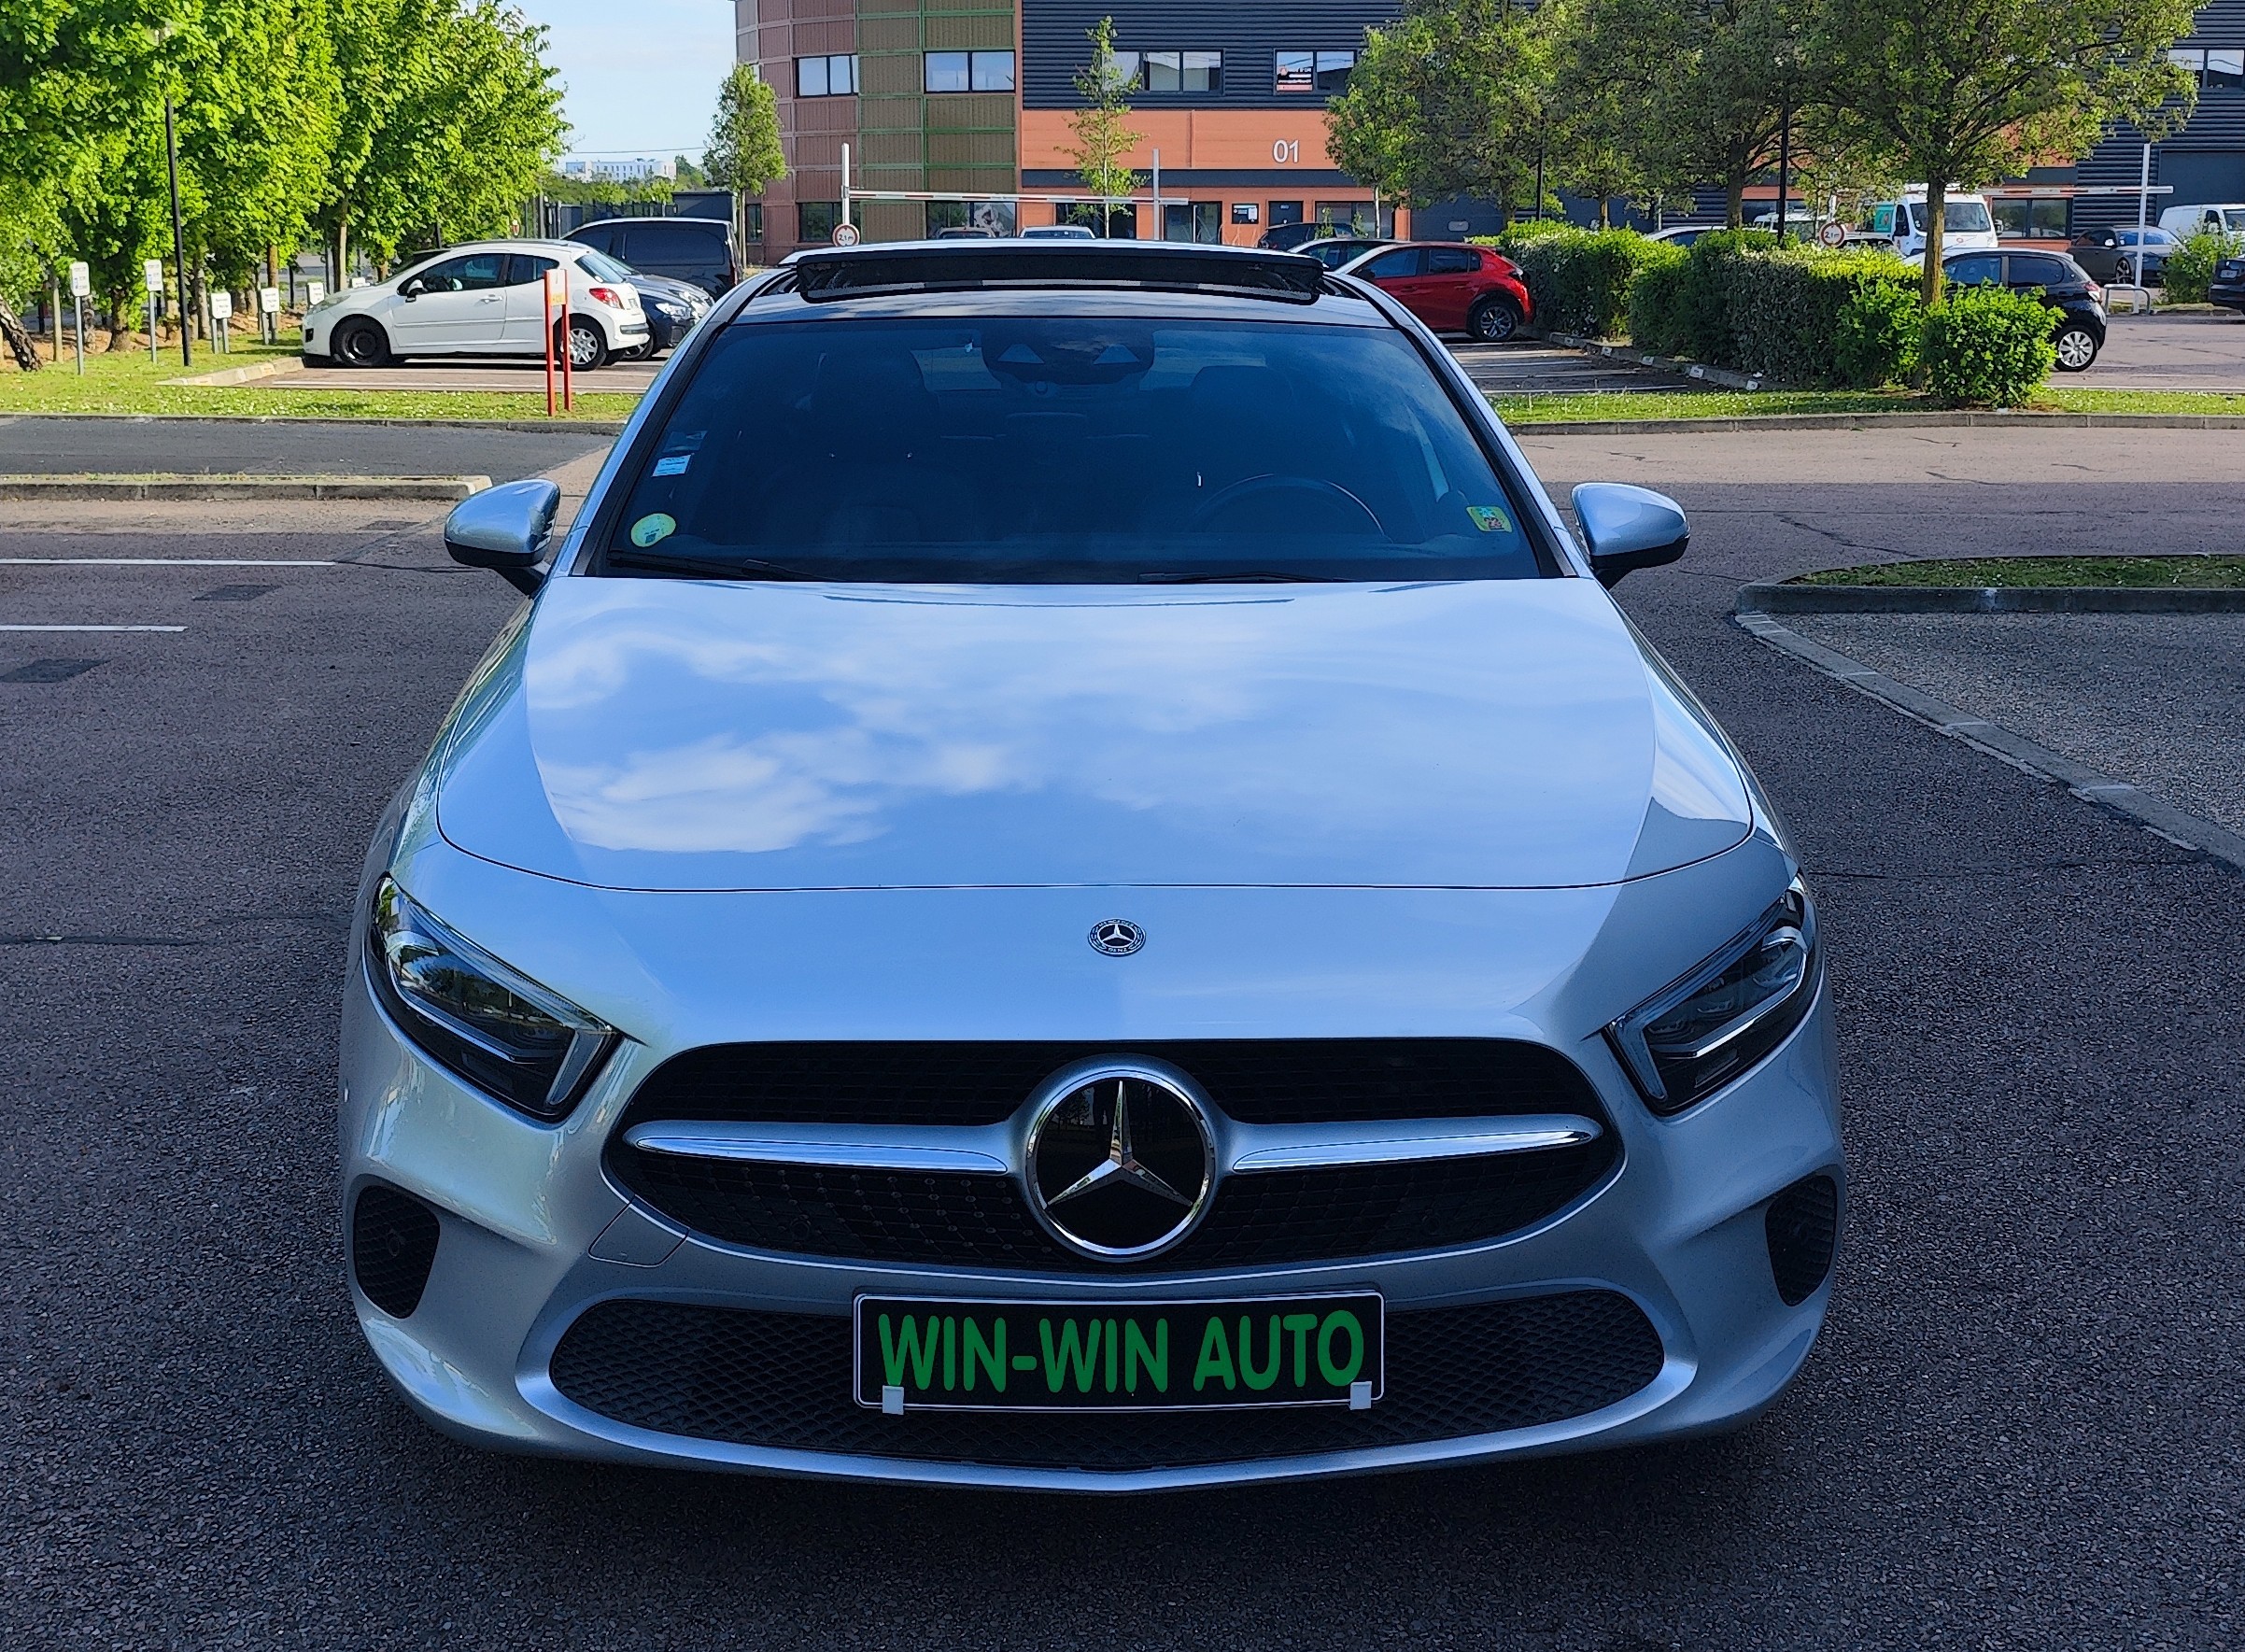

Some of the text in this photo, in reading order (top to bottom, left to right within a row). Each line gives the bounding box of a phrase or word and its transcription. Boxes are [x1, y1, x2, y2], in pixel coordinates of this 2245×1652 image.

[1273, 139, 1300, 163] 01
[878, 1309, 1364, 1393] WIN-WIN AUTO
